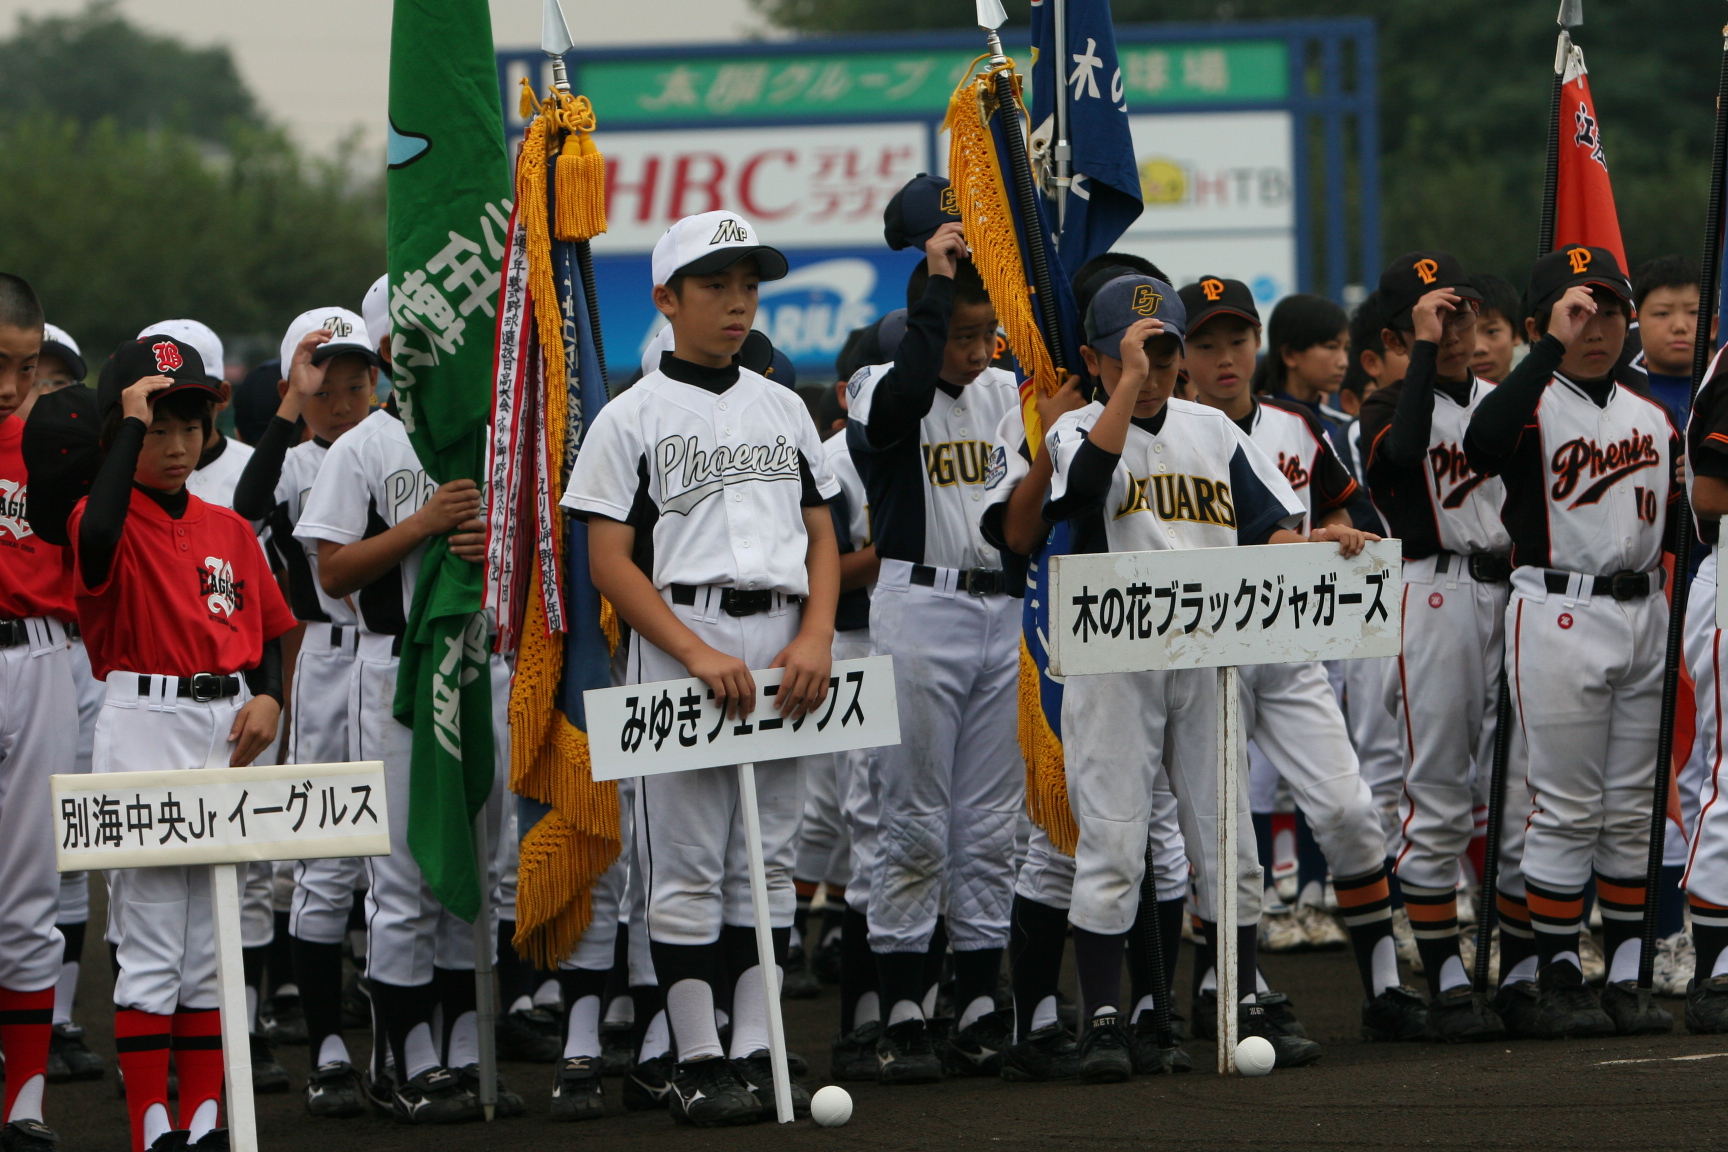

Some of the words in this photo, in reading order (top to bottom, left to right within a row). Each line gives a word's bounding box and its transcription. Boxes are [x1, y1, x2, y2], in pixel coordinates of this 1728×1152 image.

[603, 150, 800, 225] HBC
[1201, 279, 1225, 301] P
[1566, 247, 1592, 274] P
[655, 434, 800, 504] Phoenix
[1112, 470, 1237, 531] JAUARS
[1634, 486, 1657, 526] 10
[1071, 568, 1391, 643] 木の花ブラックジャガーズ
